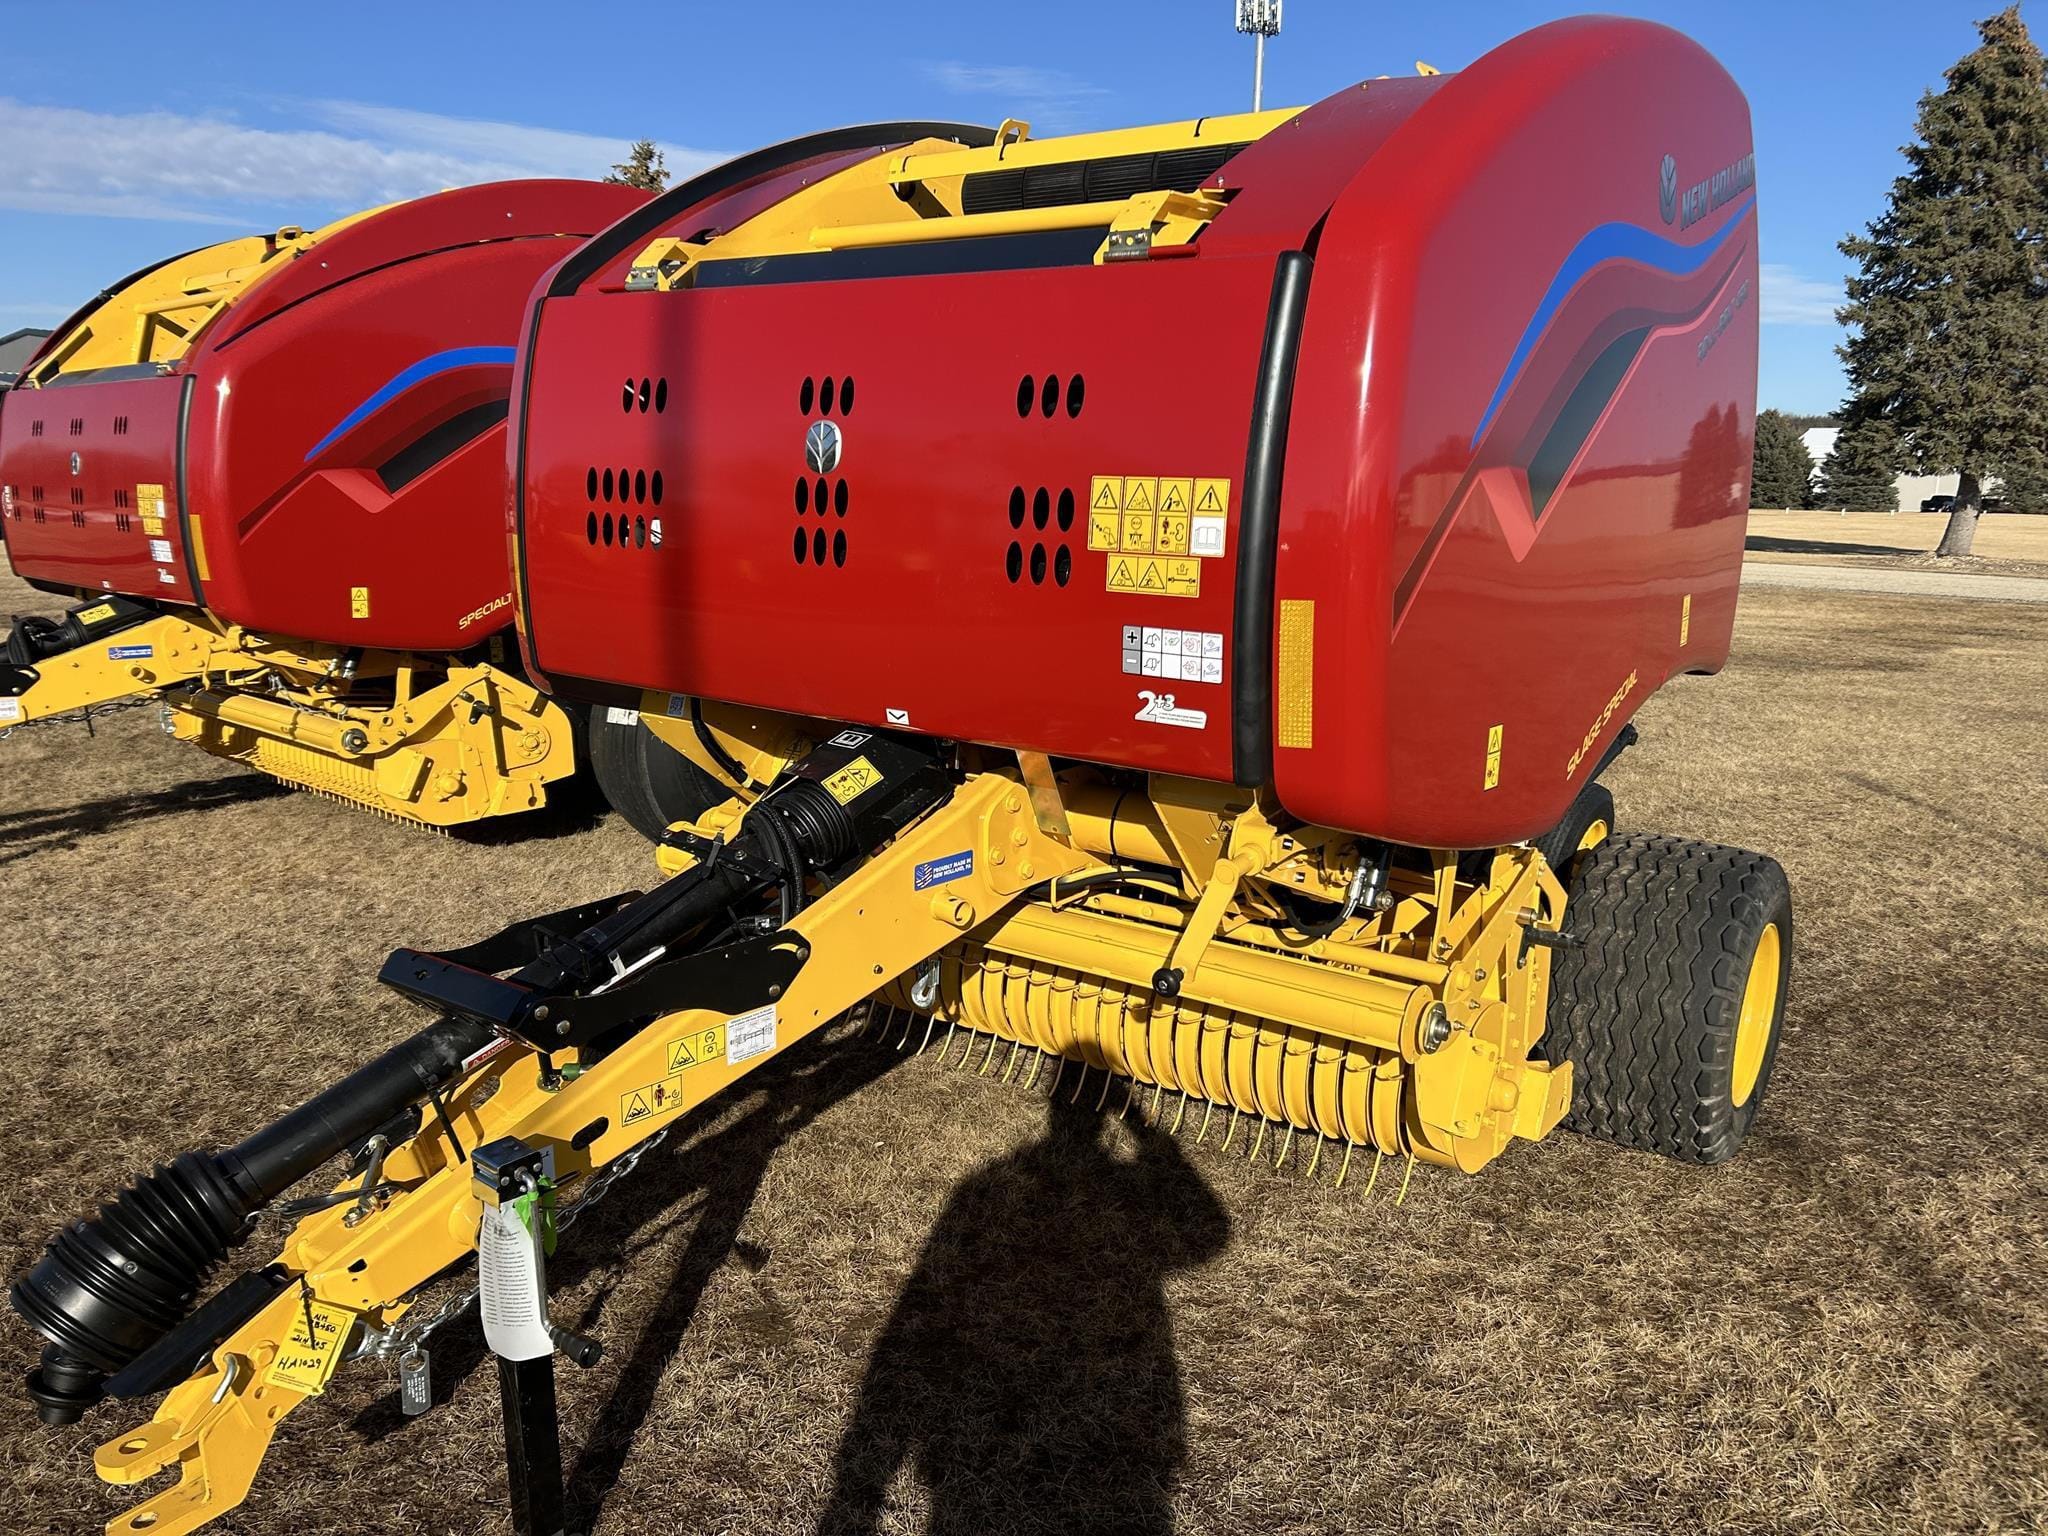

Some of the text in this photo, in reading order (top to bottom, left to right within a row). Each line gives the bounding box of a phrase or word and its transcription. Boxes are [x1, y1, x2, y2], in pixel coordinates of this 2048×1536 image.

[1680, 151, 1755, 230] NEW HOLLAND
[1566, 668, 1638, 781] SILAGE SPECIAL
[932, 871, 944, 880] NEW
[933, 862, 953, 873] PROUDLY
[953, 858, 966, 868] MADE
[481, 1038, 511, 1060] DANGER
